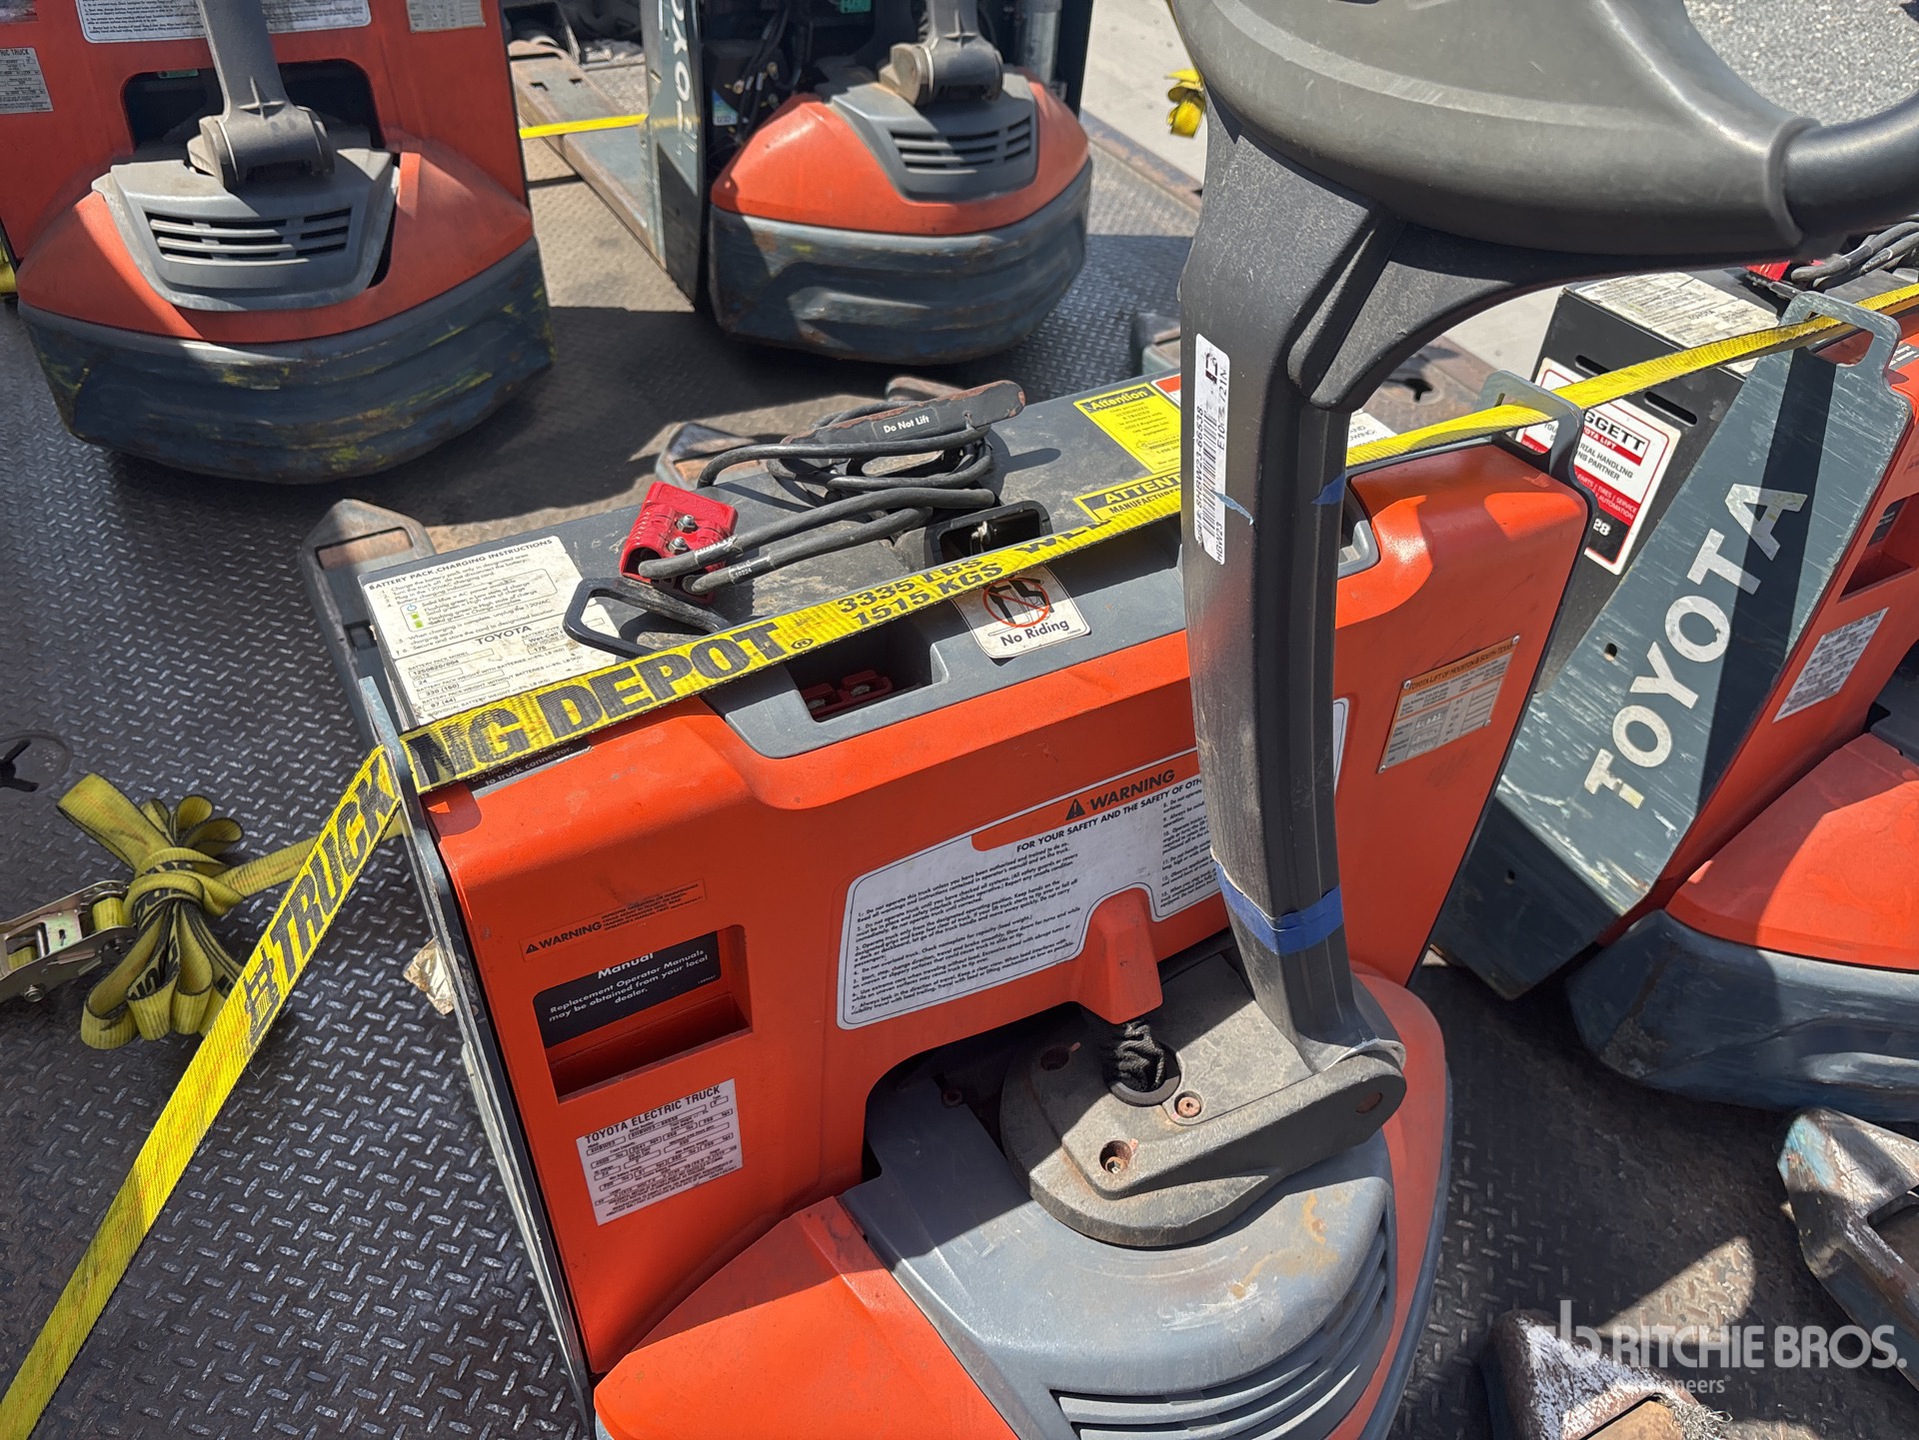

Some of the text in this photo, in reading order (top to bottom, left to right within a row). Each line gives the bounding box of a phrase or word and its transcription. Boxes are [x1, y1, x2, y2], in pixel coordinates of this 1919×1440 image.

[1090, 390, 1147, 411] Attention
[883, 414, 930, 434] Do Not Lift
[1584, 411, 1646, 451] GGETT
[1599, 434, 1617, 451] LIFT
[1587, 456, 1621, 482] PARTNER
[1596, 450, 1634, 480] HANDLING
[1216, 522, 1224, 564] HBW23
[368, 538, 553, 590] BATTERY PACK CHARGING INSTRUCTIONS
[838, 578, 916, 614] 3335
[923, 557, 983, 584] LBS
[851, 562, 1003, 626] 1515 KGS
[475, 625, 532, 645] TOYOTA
[1000, 618, 1070, 648] No Riding
[1583, 483, 1808, 811] TOYOTA
[537, 621, 790, 740] DEPOT
[485, 778, 496, 786] to
[497, 766, 525, 781] truck
[525, 746, 574, 770] connector.
[1090, 769, 1176, 811] WARNING
[1016, 839, 1036, 854] FOR
[1038, 830, 1065, 846] YOUR
[1067, 818, 1100, 836] SAFETY
[1100, 810, 1121, 824] AND
[1123, 803, 1139, 816] THE
[1140, 791, 1171, 809] SAFETY
[1172, 784, 1187, 796] OF
[874, 903, 884, 911] not
[884, 895, 906, 909] operate
[906, 891, 916, 901] this
[917, 887, 931, 897] truck
[931, 881, 949, 892] unless
[949, 878, 960, 887] you
[960, 872, 974, 882] have
[974, 867, 988, 878] been
[988, 858, 1016, 873] authorized
[1027, 848, 1046, 860] trained
[880, 902, 905, 916] warnings
[906, 897, 917, 906] and
[917, 886, 948, 902] instructions
[1007, 859, 1027, 872] manual
[1028, 856, 1038, 865] and
[538, 920, 602, 950] WARNING
[908, 912, 929, 926] operate
[930, 908, 944, 918] truck
[944, 904, 957, 913] until
[549, 948, 705, 1014] Replacement Operator Manuals
[597, 952, 654, 980] Manual
[548, 1008, 573, 1024] may
[574, 1000, 588, 1014] be
[589, 983, 634, 1009] obtained
[635, 976, 661, 993] from
[661, 966, 684, 984] your
[685, 954, 709, 970] local
[613, 987, 648, 1006] dealer.
[585, 1084, 721, 1145] TOYOTA ELECTRIC TRUCK
